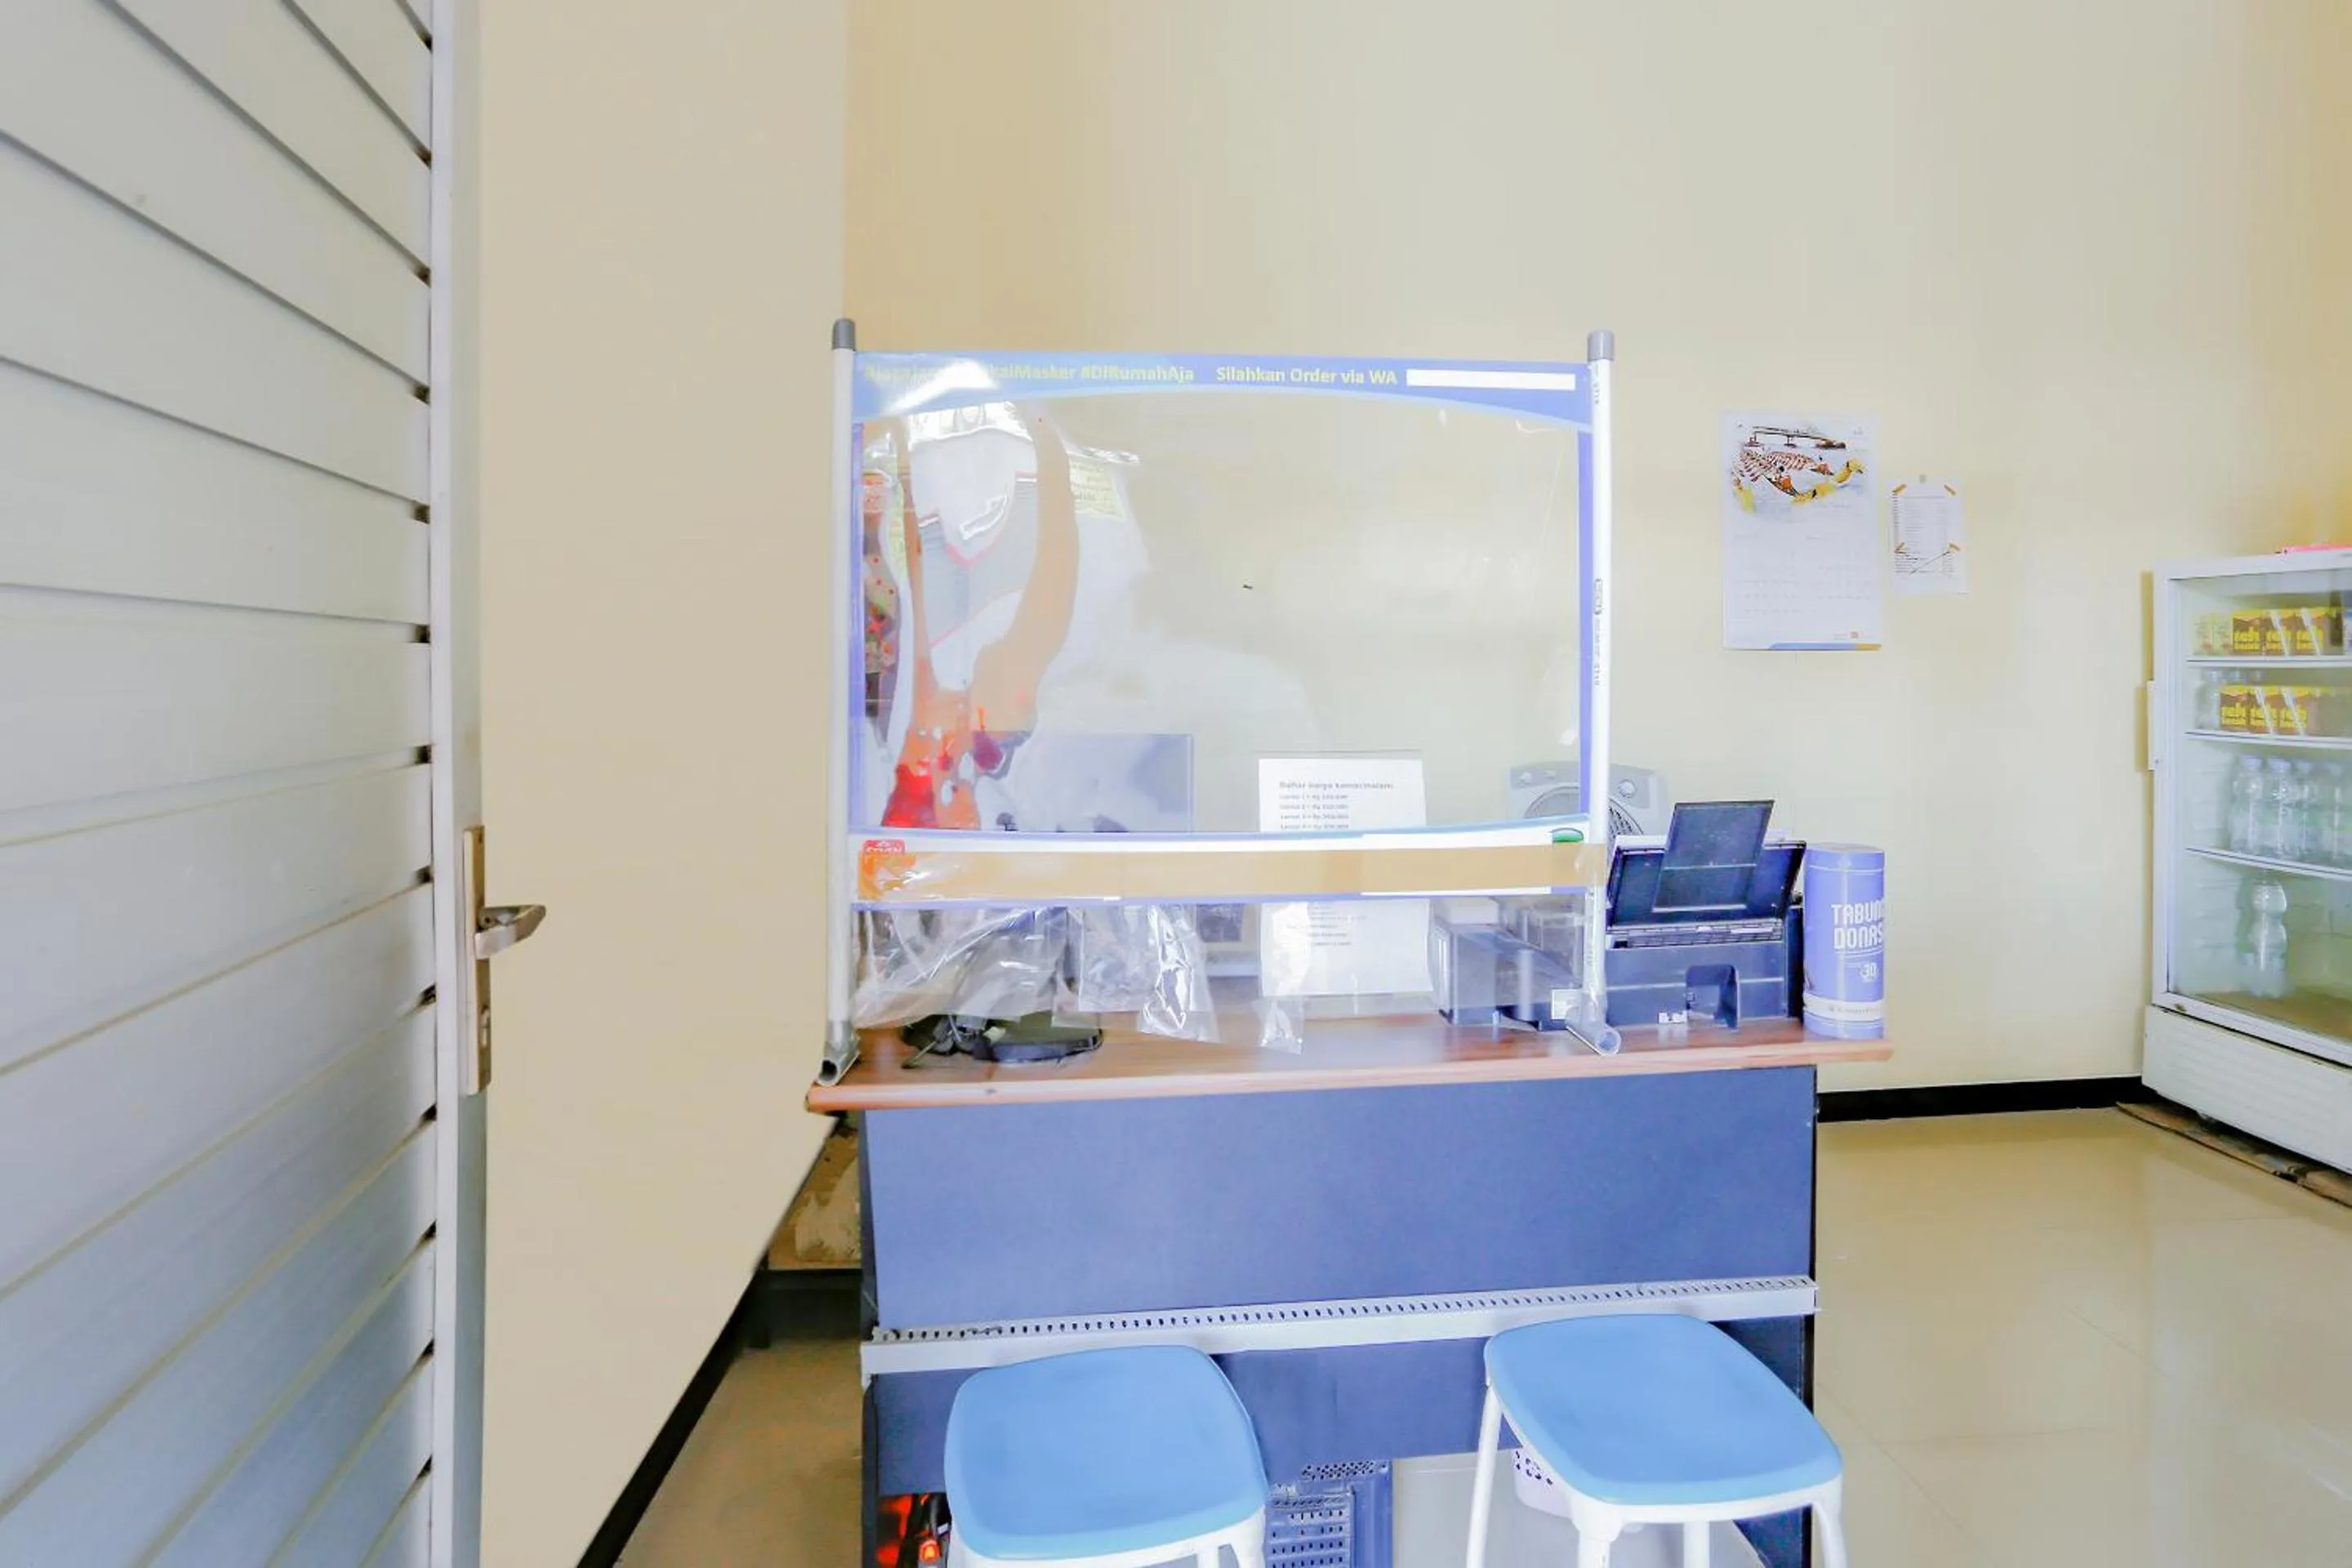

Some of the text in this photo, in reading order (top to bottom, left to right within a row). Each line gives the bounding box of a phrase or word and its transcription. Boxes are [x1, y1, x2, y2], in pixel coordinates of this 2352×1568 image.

[982, 363, 1076, 380] kaiMasker
[1215, 366, 1285, 382] Silahkan
[1290, 368, 1337, 383] Order
[1340, 369, 1365, 384] via
[1369, 369, 1398, 385] WA
